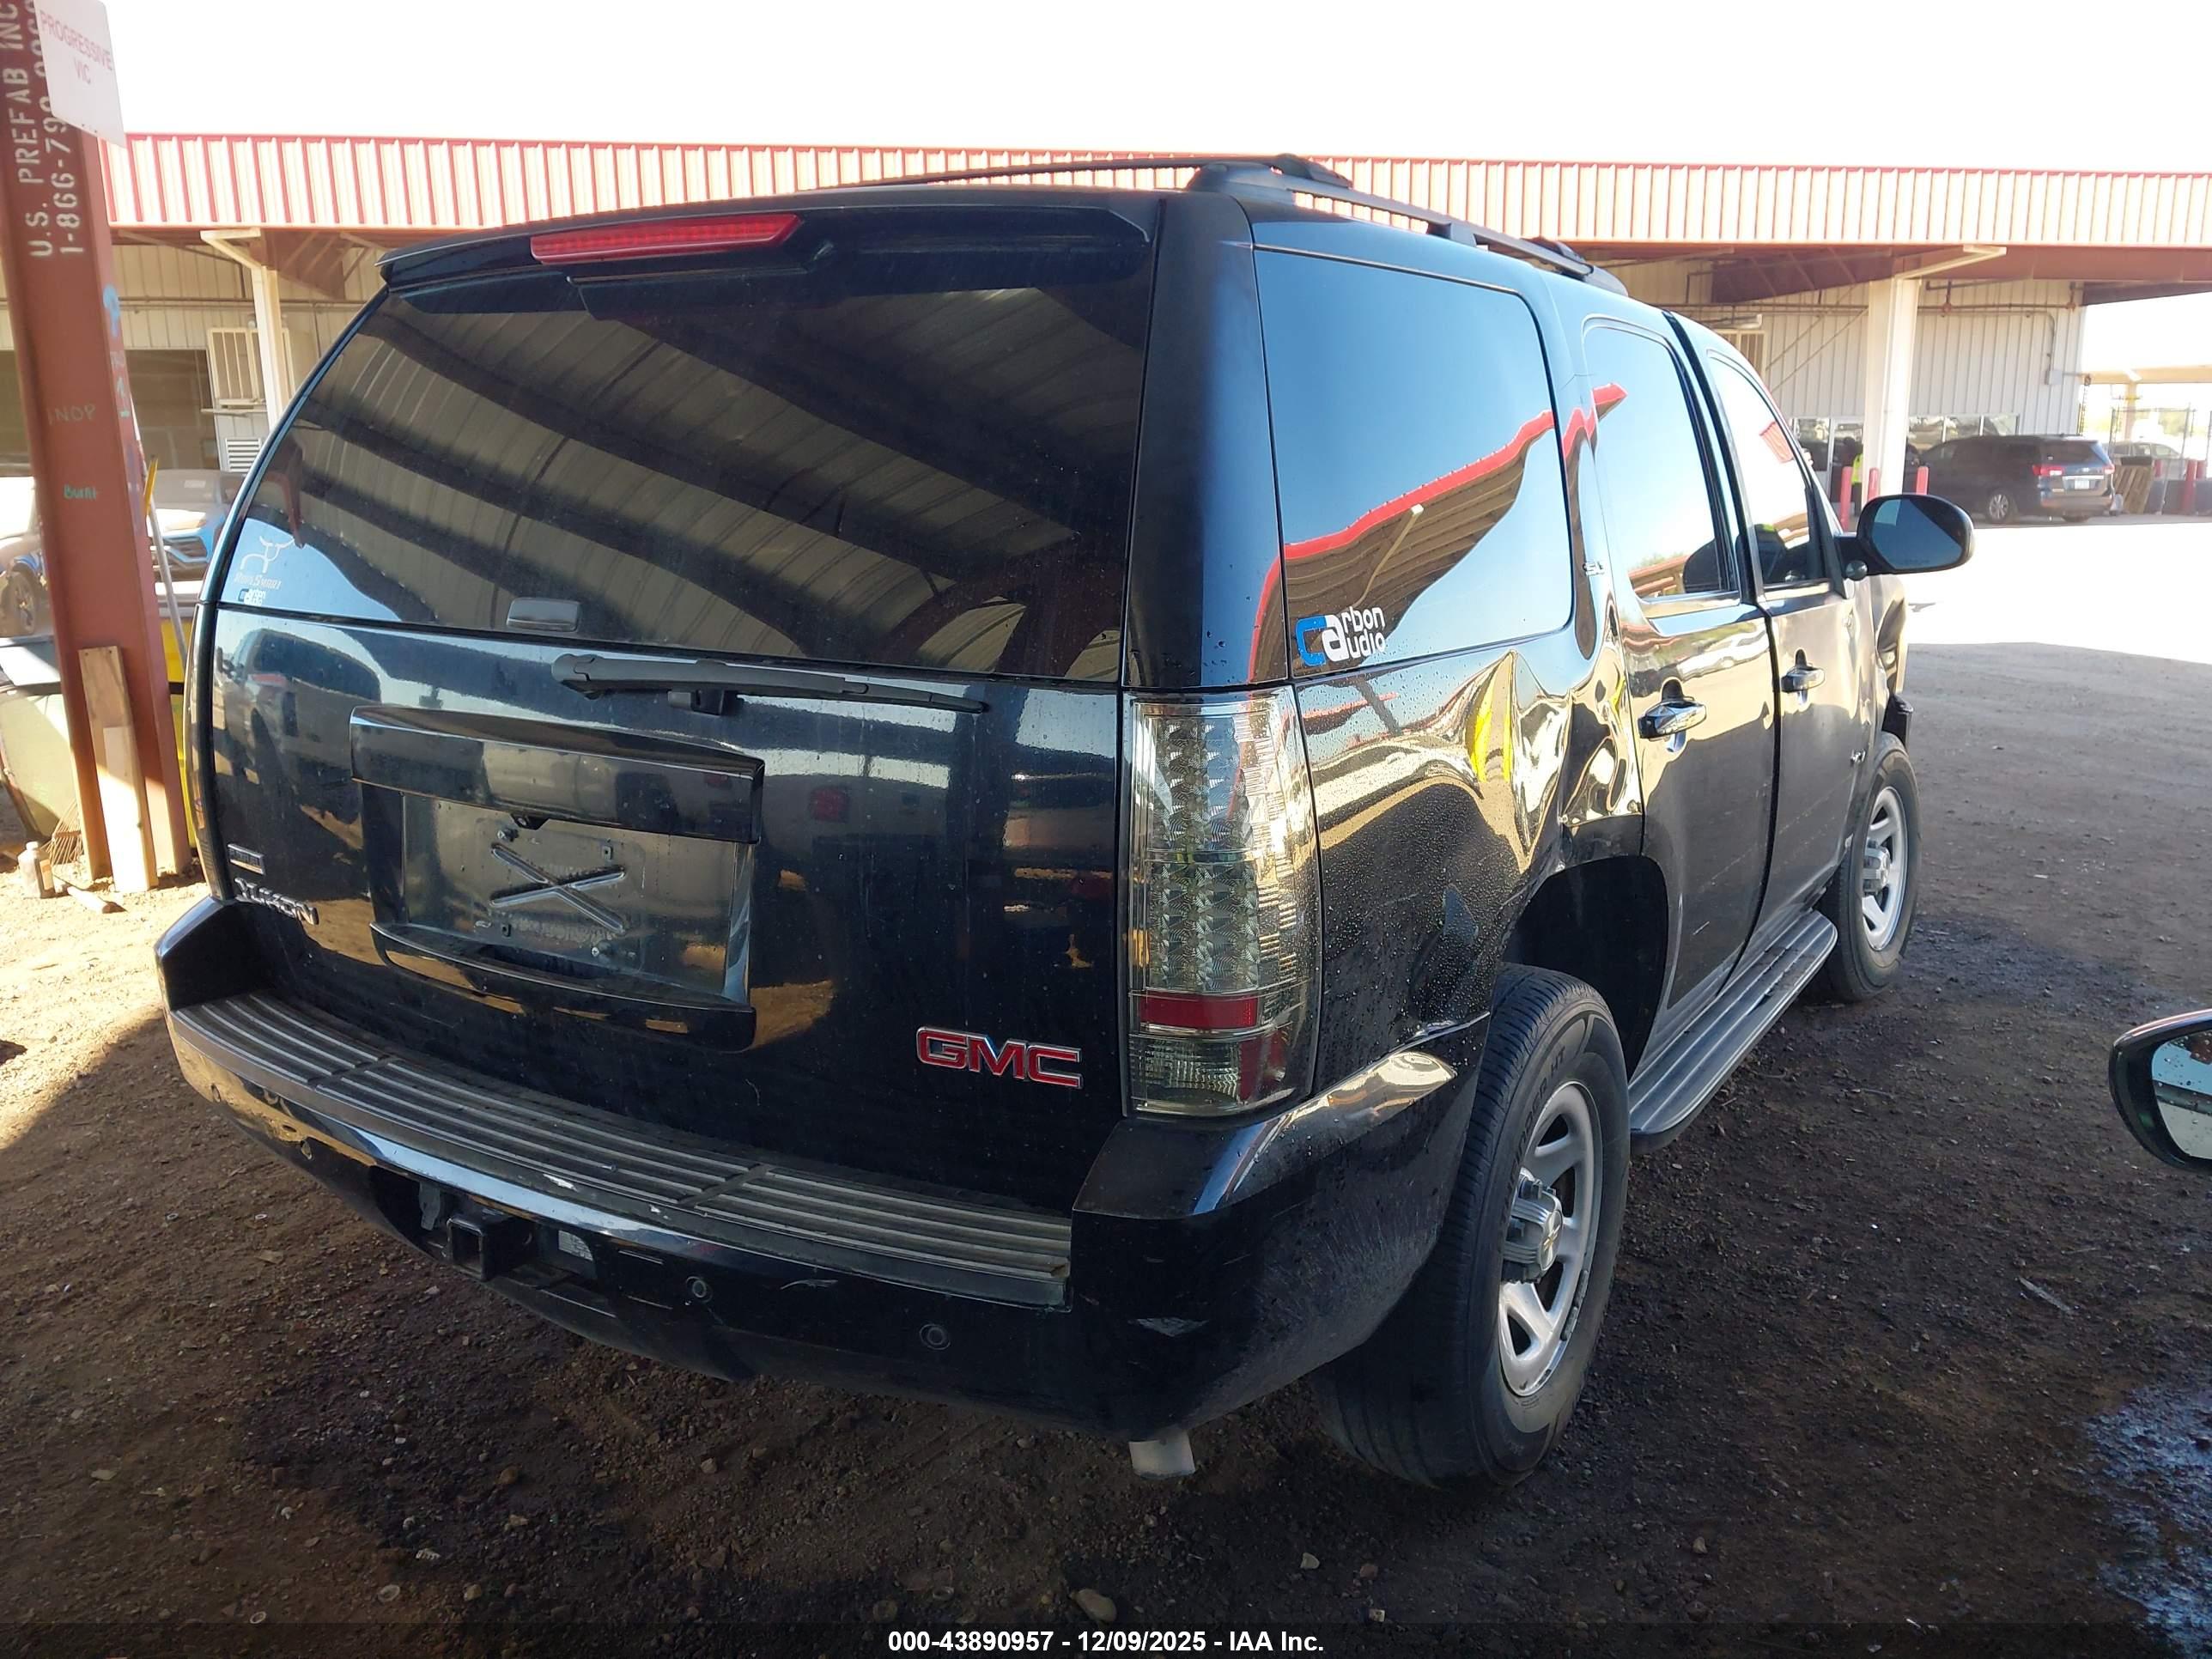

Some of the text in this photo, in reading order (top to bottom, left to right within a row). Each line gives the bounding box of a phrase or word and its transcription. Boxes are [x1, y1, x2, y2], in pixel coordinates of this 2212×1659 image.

[40, 9, 112, 71] PROGRESSIVE
[3, 68, 44, 184] PREFAB
[25, 202, 53, 258] U.S.
[916, 1025, 1084, 1089] GMC
